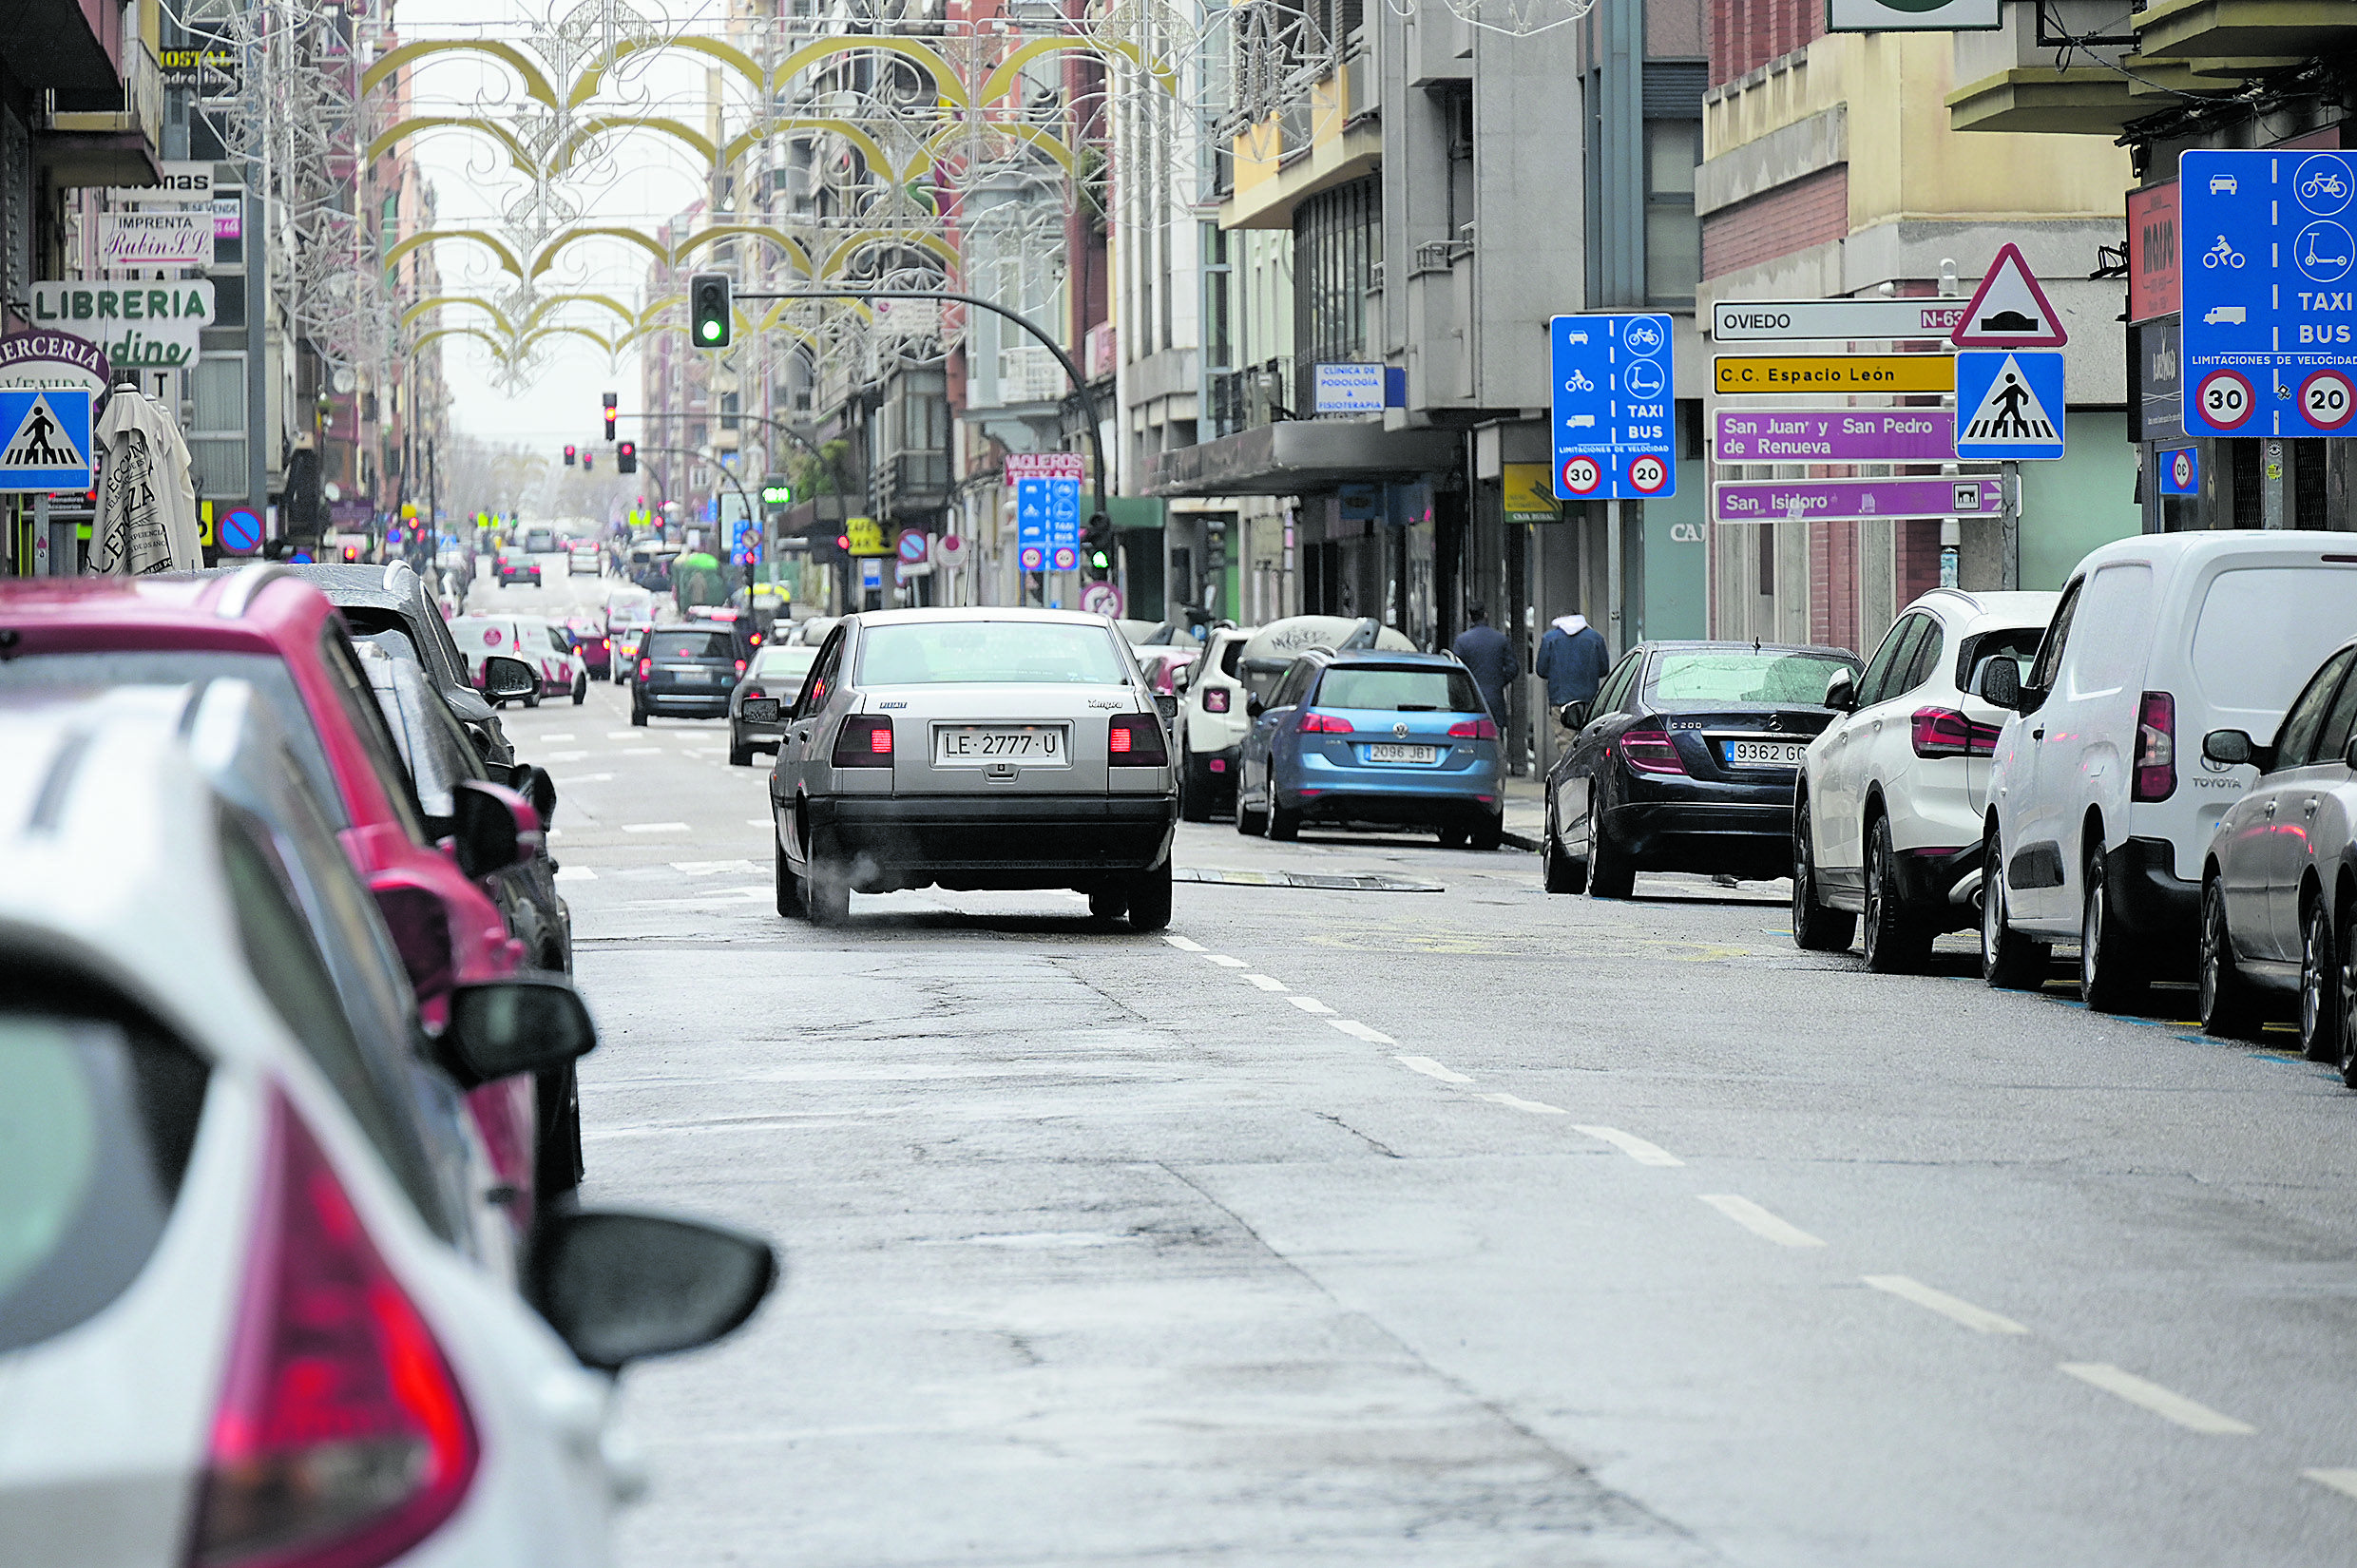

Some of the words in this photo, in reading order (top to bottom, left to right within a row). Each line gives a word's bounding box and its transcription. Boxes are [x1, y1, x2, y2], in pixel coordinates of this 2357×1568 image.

[119, 217, 193, 229] IMPRENTA
[36, 289, 206, 319] LIBRERIA
[2298, 293, 2352, 311] TAXI
[1724, 314, 1791, 329] OVIEDO
[2299, 325, 2351, 343] BUS
[0, 336, 100, 372] ERCERIA
[2192, 355, 2271, 365] LIMITACIONES
[2276, 355, 2291, 365] DE
[1721, 369, 1759, 382] C.C.
[1768, 368, 1842, 385] Espacio
[1849, 365, 1895, 381] León
[2208, 390, 2242, 410] 30
[2310, 390, 2345, 410] 20
[1626, 404, 1664, 419] TAXI
[1628, 425, 1663, 439] BUS
[1724, 418, 1756, 434] San
[1767, 418, 1807, 434] Juan
[1818, 421, 1829, 437] y
[1842, 418, 1875, 434] San
[1884, 416, 1933, 433] Pedro
[1559, 446, 1612, 454] LIMITACIONES
[1614, 445, 1625, 453] DE
[1627, 444, 1669, 453] VELOCIDAD
[1724, 438, 1745, 454] de
[1758, 438, 1831, 454] Renueva
[1570, 468, 1593, 482] 30
[1637, 468, 1659, 481] 20
[1726, 494, 1758, 510] San
[1772, 492, 1828, 510] Isidoro
[1087, 699, 1123, 710] Tempra
[1372, 745, 1405, 758] 2096
[1737, 743, 1779, 760] 9362
[2193, 777, 2242, 788] TOYOTA
